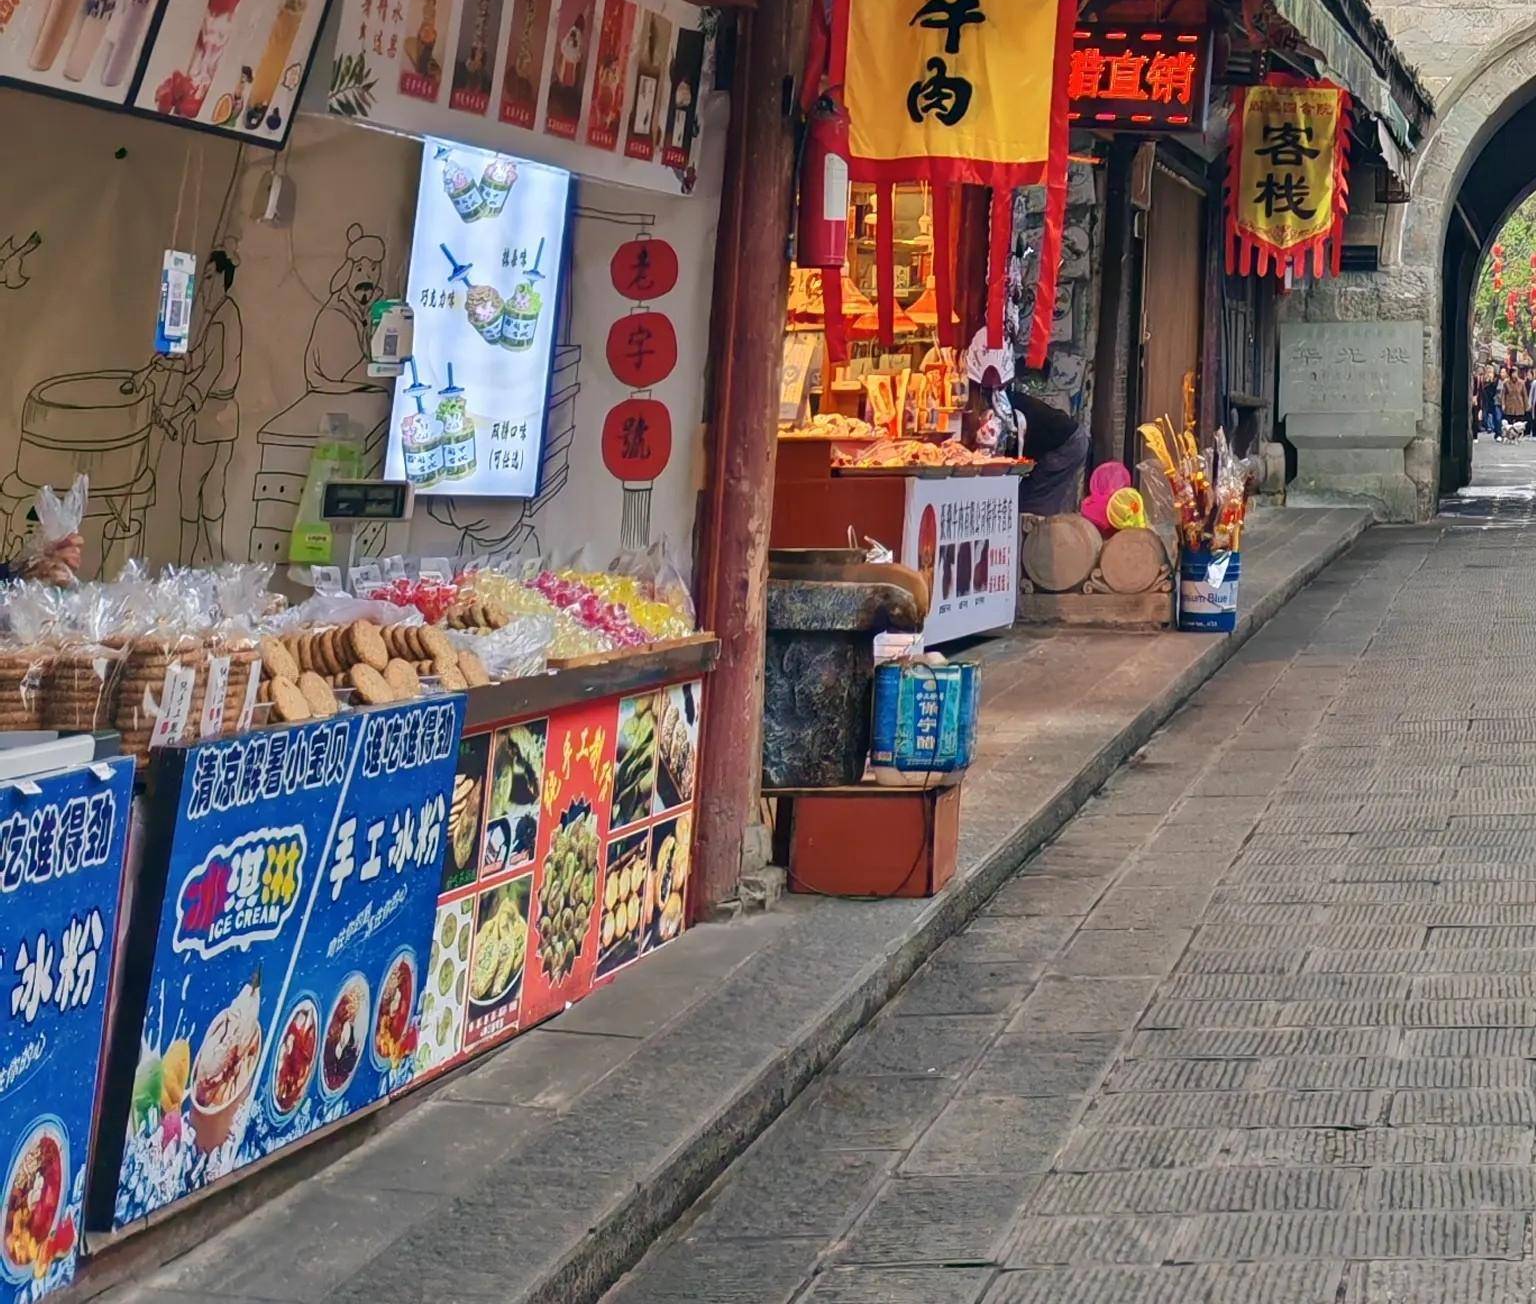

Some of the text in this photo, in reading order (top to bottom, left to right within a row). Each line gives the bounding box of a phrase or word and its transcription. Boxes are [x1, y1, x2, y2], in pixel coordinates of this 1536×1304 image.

[1254, 122, 1321, 220] 客栈
[186, 720, 352, 822] 清凉解暑小宝贝
[362, 704, 456, 778] 谁吃谁得劲
[182, 840, 301, 933] 冰淇淋
[327, 792, 446, 902] 手工冰粉
[11, 905, 104, 1023] 冰粉
[208, 904, 281, 943] ICE CREAM
